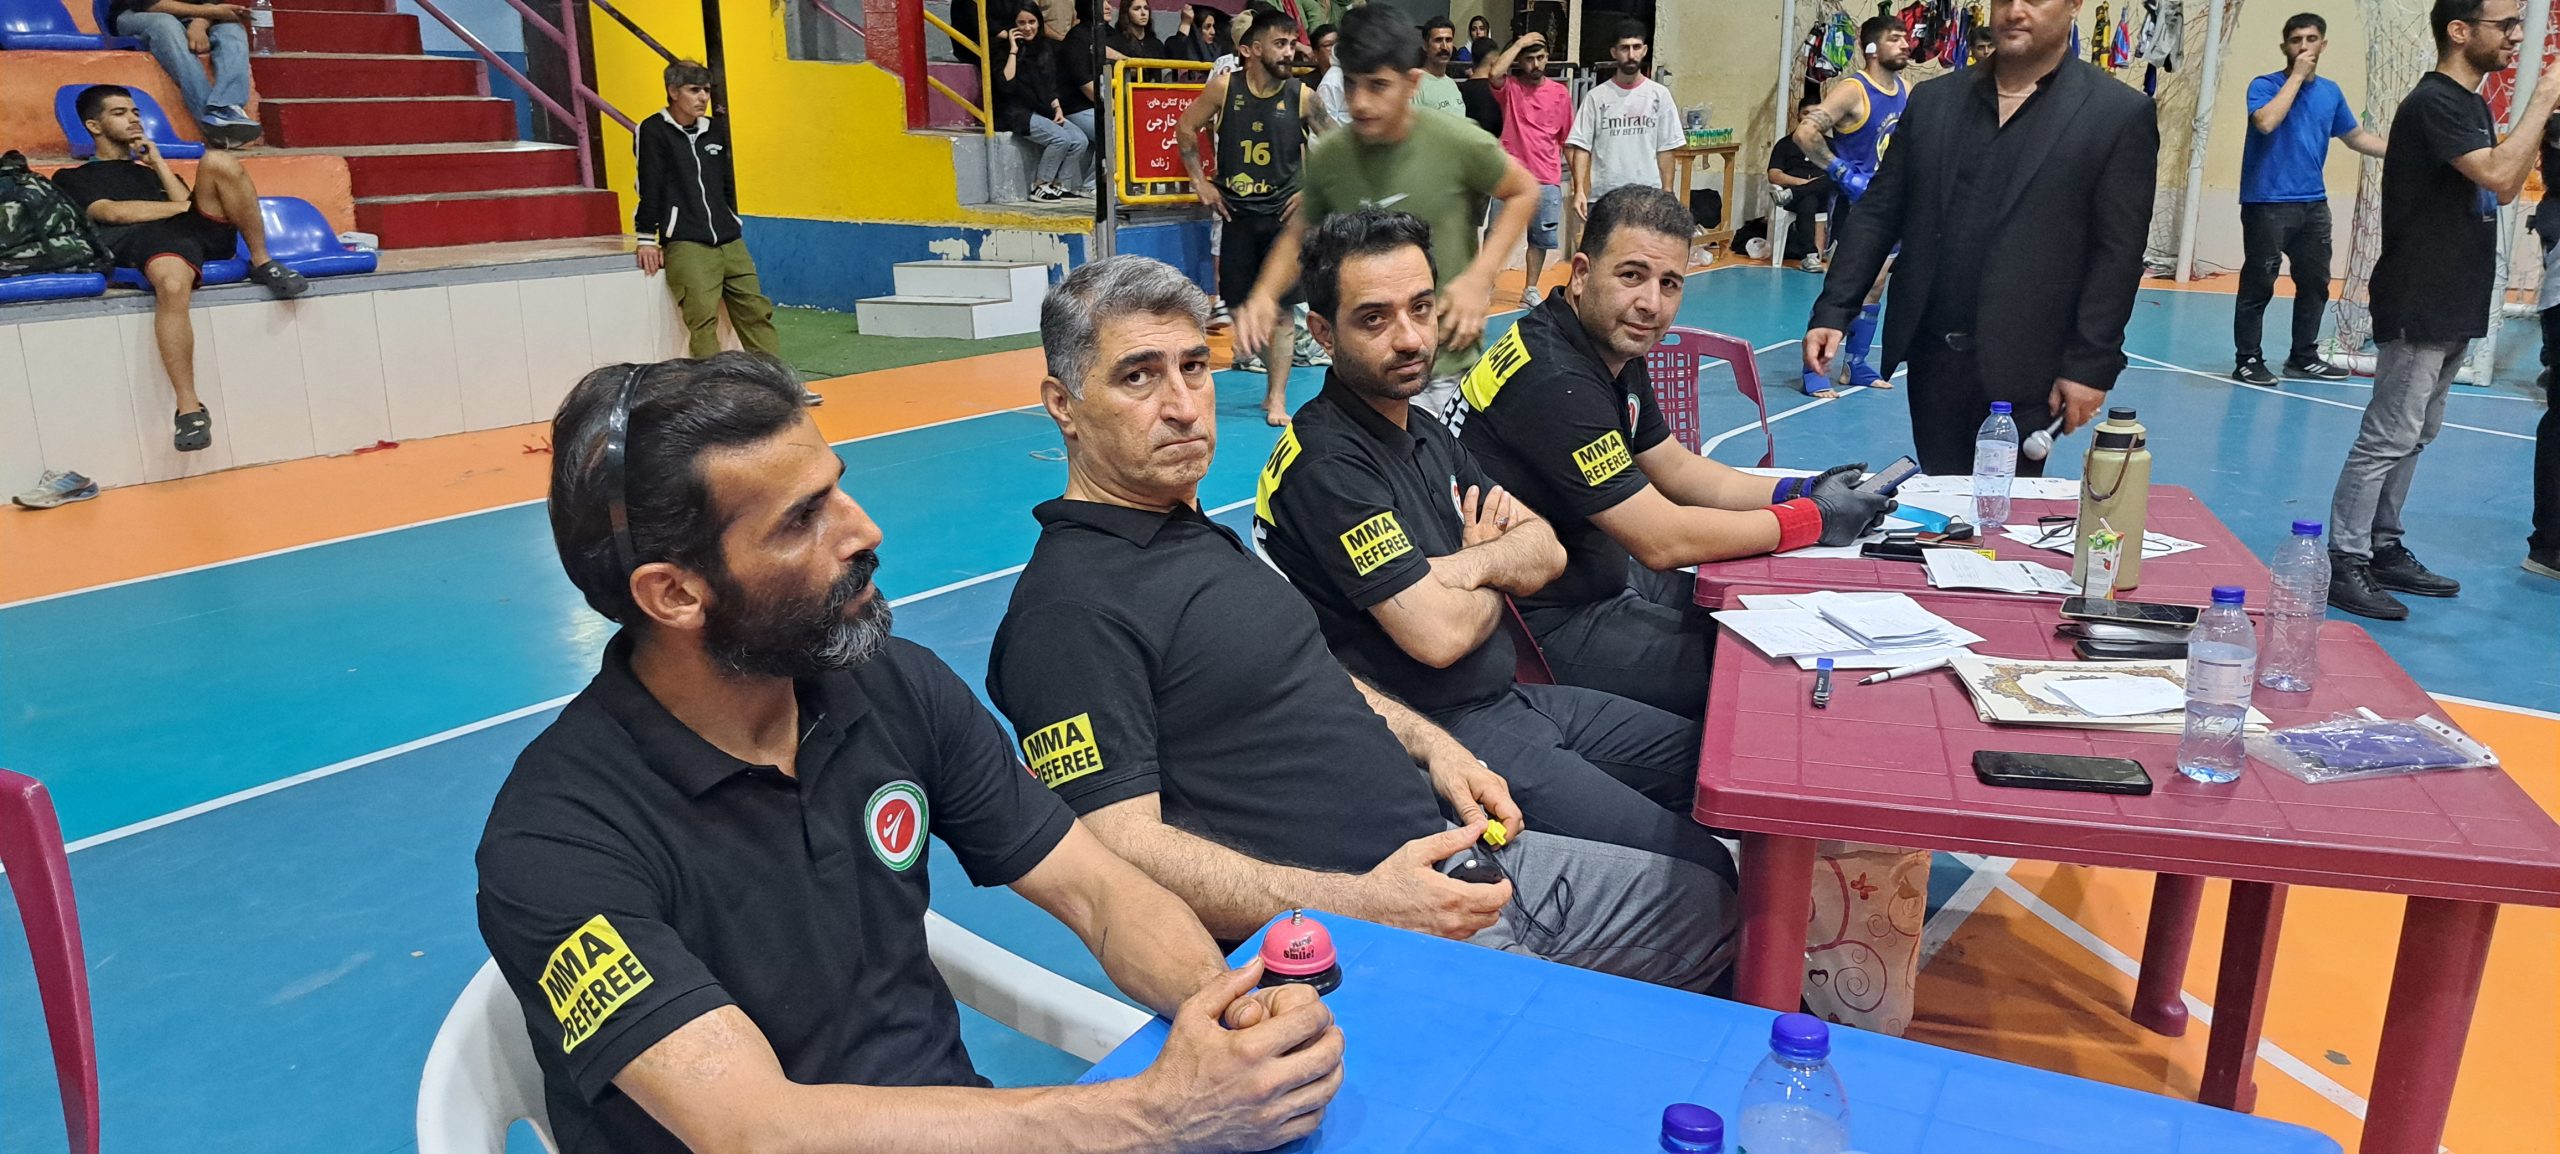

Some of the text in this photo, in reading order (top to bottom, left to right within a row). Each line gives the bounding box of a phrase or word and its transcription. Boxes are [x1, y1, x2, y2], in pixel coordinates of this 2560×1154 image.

[1146, 113, 1178, 133] خارجی
[1601, 114, 1656, 130] Emirates
[1240, 139, 1271, 166] 16
[1578, 434, 1621, 466] MMA
[1584, 448, 1631, 484] REFEREE
[1346, 516, 1397, 551] MMA
[1354, 533, 1409, 572] REFEREE
[1027, 721, 1086, 762] MMA
[1034, 745, 1099, 785] REFEREE
[545, 931, 616, 1009] MMA
[1283, 948, 1314, 960] Smile!
[562, 953, 647, 1047] REFEREE
